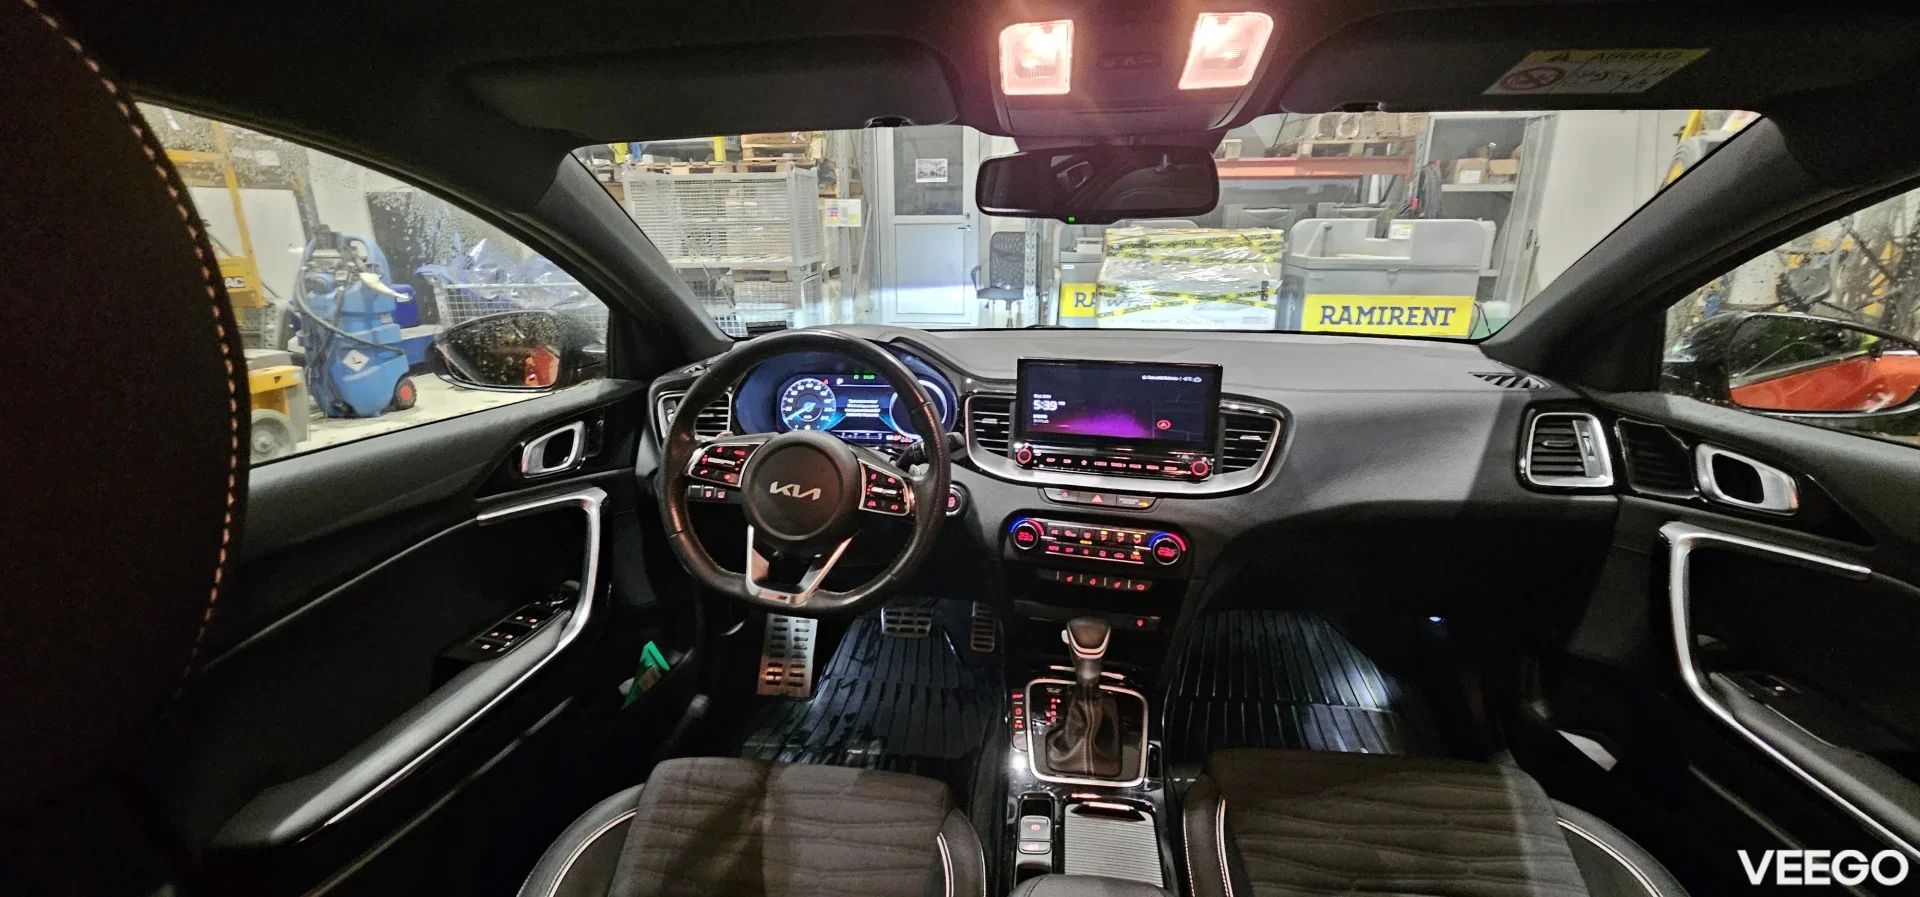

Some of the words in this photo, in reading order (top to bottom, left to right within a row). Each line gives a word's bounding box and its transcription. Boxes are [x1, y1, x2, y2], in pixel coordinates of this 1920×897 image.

[1319, 305, 1456, 326] RAMIRENT
[1033, 400, 1058, 411] 5:39
[769, 481, 821, 500] KIA
